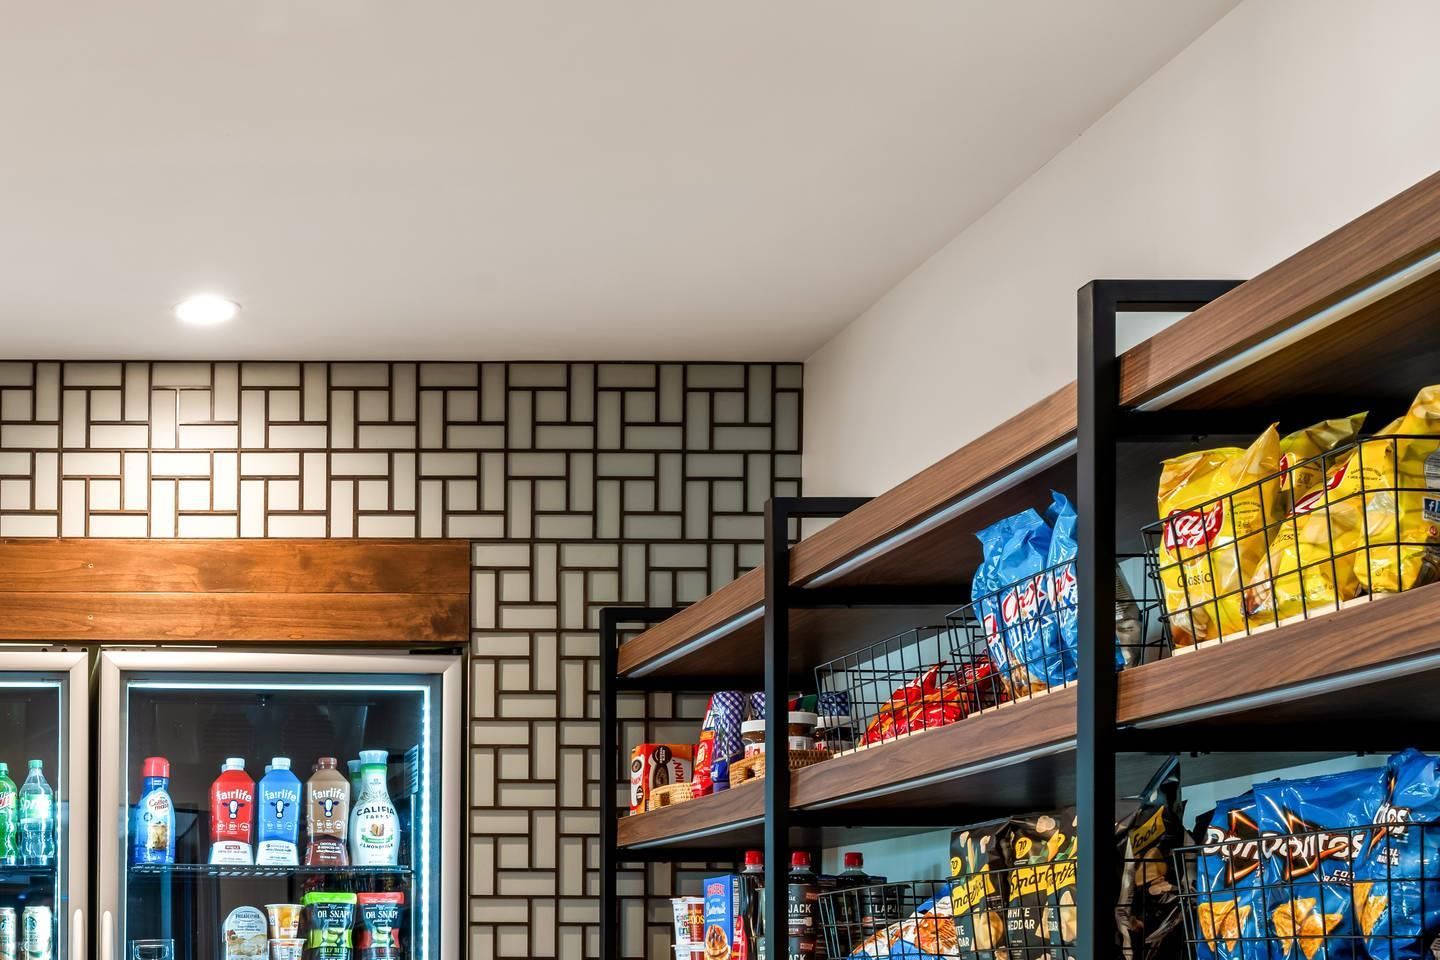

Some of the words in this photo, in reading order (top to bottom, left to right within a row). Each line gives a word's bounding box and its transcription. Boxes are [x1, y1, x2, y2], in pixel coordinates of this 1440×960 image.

[1166, 503, 1221, 548] Lay's
[215, 789, 253, 802] fairlife
[264, 789, 297, 801] fairlife
[312, 788, 346, 800] fairlife
[356, 806, 396, 817] CALIFIA
